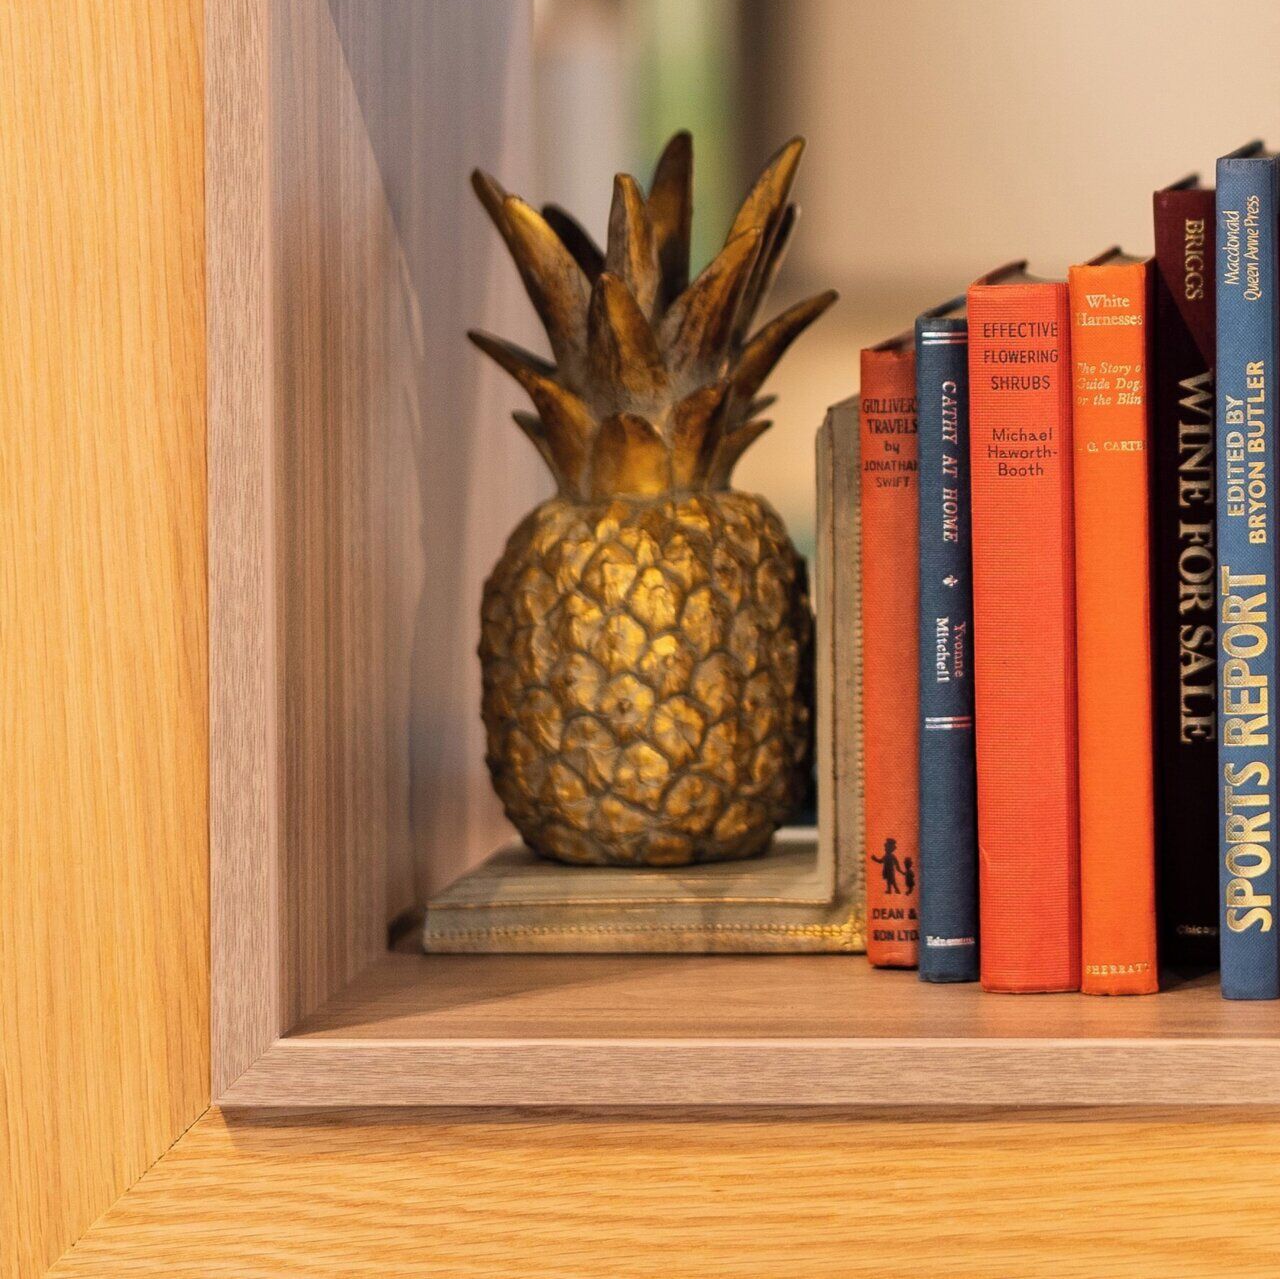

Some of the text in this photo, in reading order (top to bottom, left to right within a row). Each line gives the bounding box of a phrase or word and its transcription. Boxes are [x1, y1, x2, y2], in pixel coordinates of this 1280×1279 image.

[1222, 209, 1241, 287] Macdonald
[1243, 194, 1263, 302] Queen Anne Press
[1184, 218, 1205, 301] BRIGGS
[1086, 294, 1131, 308] White
[983, 322, 1059, 338] EFFECTIVE
[983, 349, 1059, 364] FLOWERING
[1100, 361, 1132, 376] Story
[991, 375, 1051, 391] SHRUBS
[1093, 392, 1113, 406] the
[1116, 392, 1143, 406] Blin
[992, 427, 1053, 441] Michael
[885, 440, 900, 455] by
[987, 445, 1059, 459] Haworth-
[1103, 440, 1144, 452] CARTE
[1246, 360, 1268, 545] BRYON BUTLER
[942, 380, 959, 543] CATHY AT HOME
[1225, 394, 1246, 517] EDITED BY
[998, 462, 1044, 477] Booth
[876, 476, 911, 489] SWIFT
[1178, 368, 1217, 745] WINE FOR SALE
[936, 616, 951, 684] Mitchell
[953, 621, 967, 678] Yvonne
[1220, 565, 1273, 934] SPORTS REPORT
[872, 907, 904, 920] DEAN
[873, 929, 895, 942] SON
